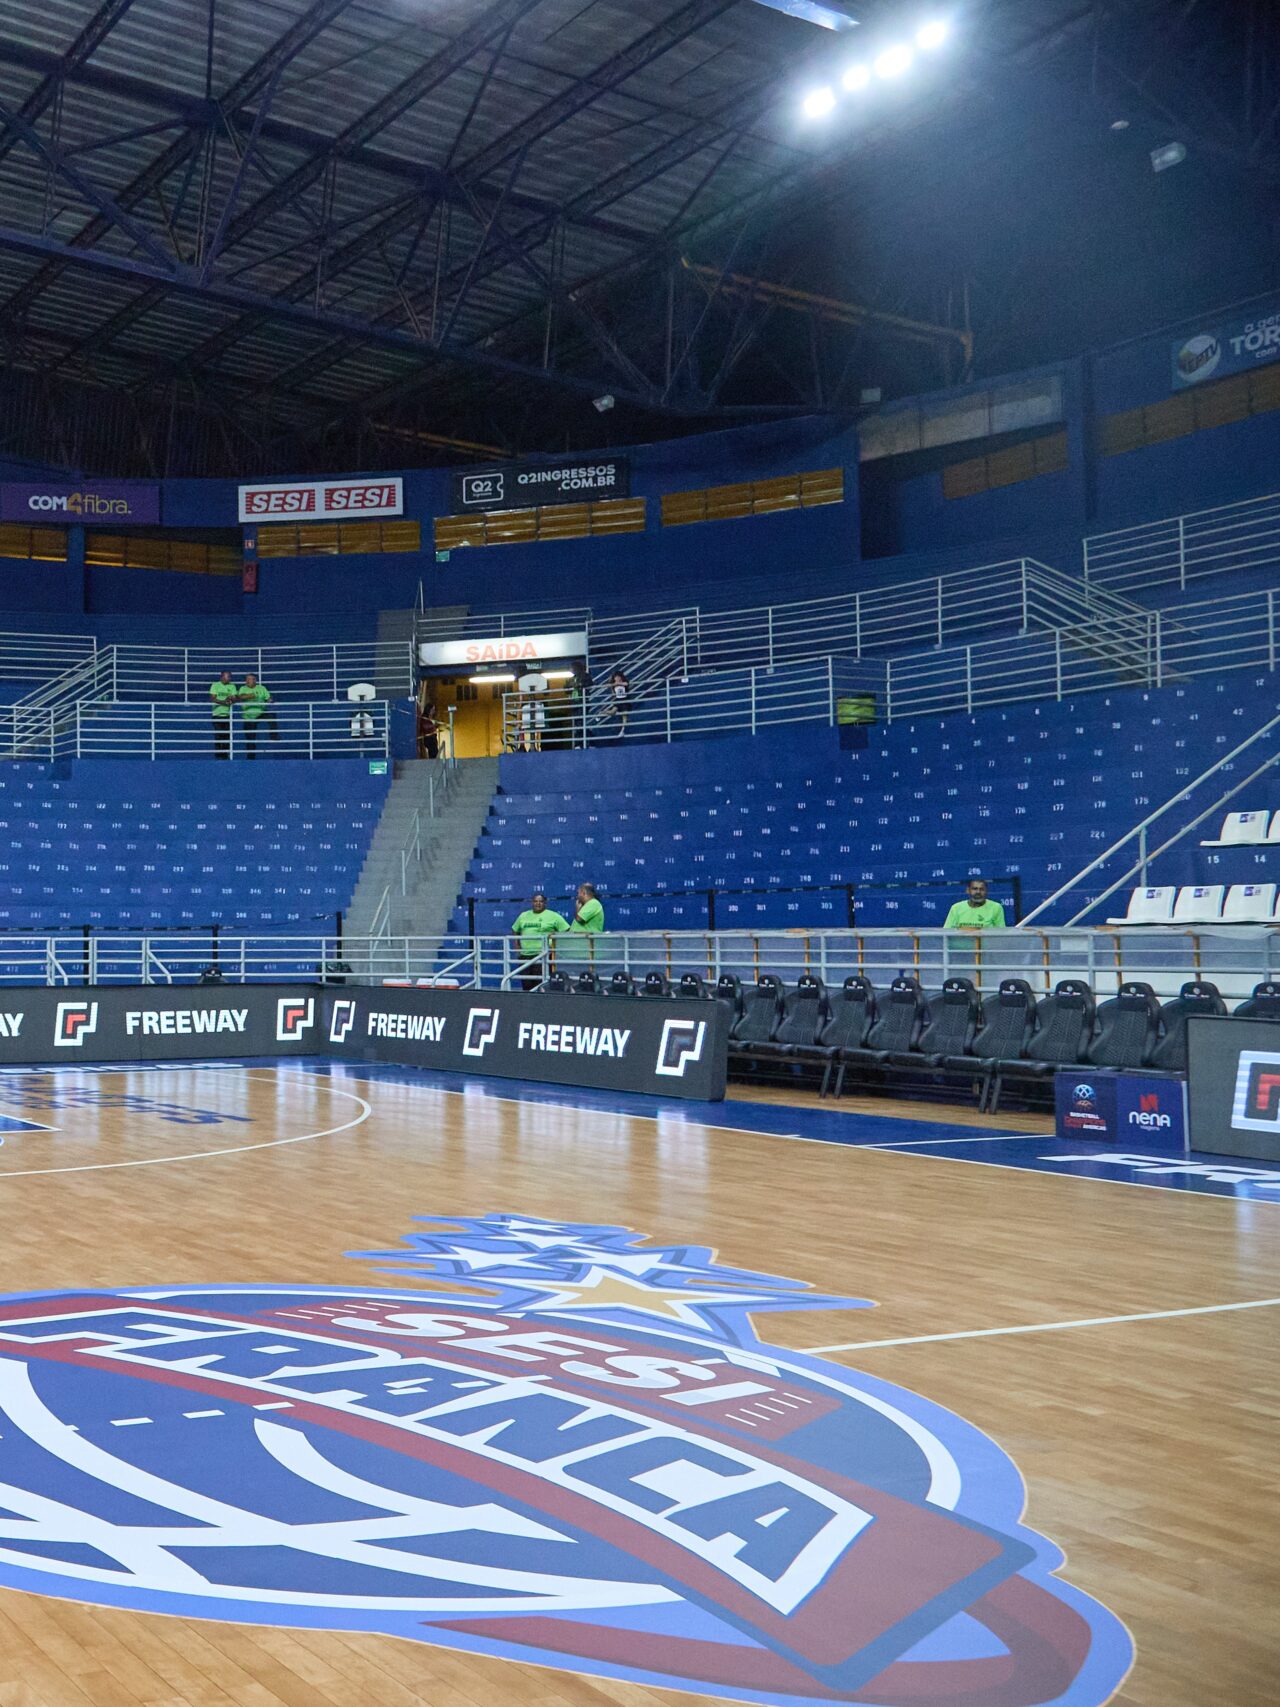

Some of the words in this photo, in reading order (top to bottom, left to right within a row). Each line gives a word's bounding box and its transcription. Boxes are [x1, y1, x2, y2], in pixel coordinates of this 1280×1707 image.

[471, 480, 493, 494] Q2
[517, 464, 616, 485] Q2INGRESSOS
[251, 490, 311, 514] SESI
[330, 485, 390, 510] SESI
[125, 1008, 249, 1035] FREEWAY
[367, 1012, 447, 1042] FREEWAY
[517, 1022, 631, 1058] FREEWAY
[333, 1307, 760, 1412] SESI
